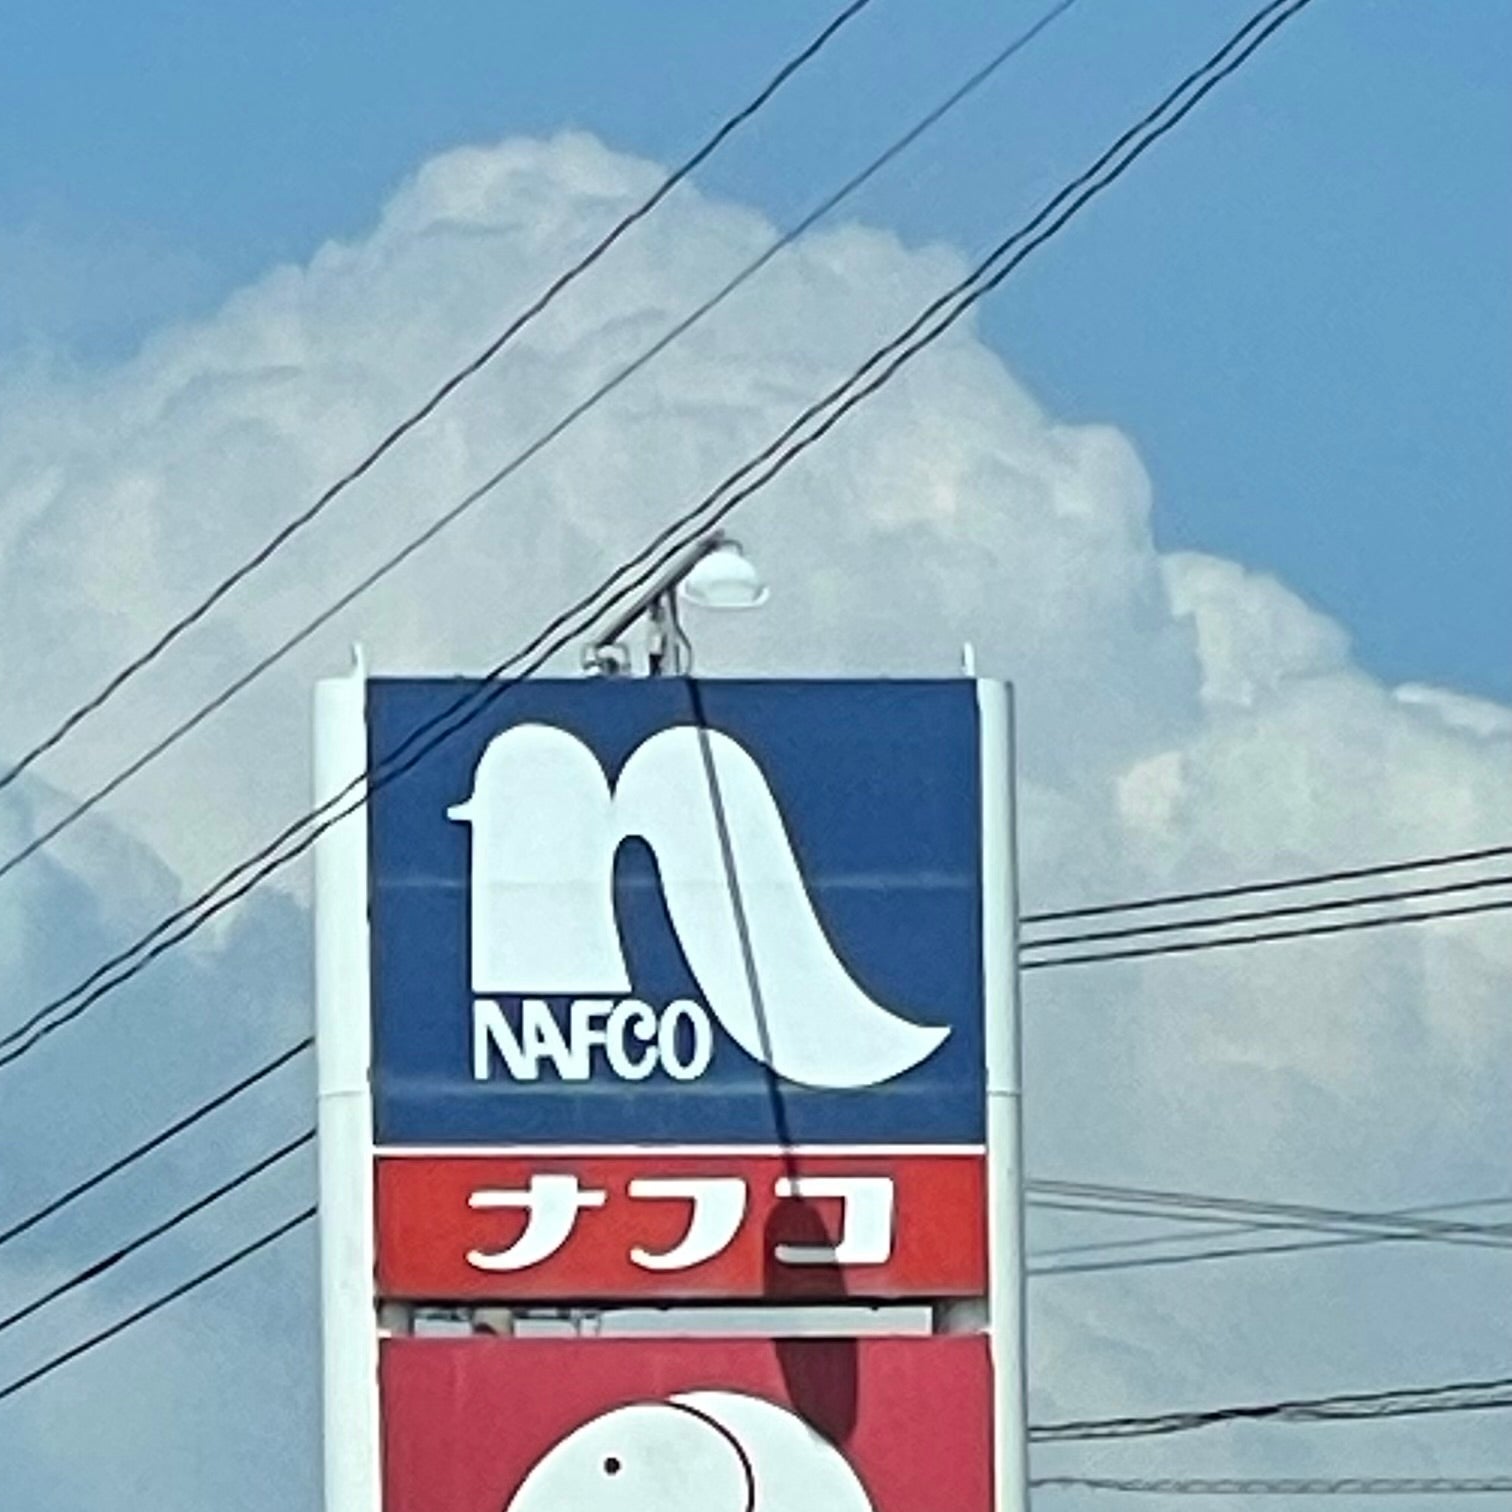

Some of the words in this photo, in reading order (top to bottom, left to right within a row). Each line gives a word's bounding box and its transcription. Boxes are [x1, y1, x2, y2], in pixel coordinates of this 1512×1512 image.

[473, 1000, 714, 1082] NAFCO
[466, 1174, 895, 1272] ナフコ
